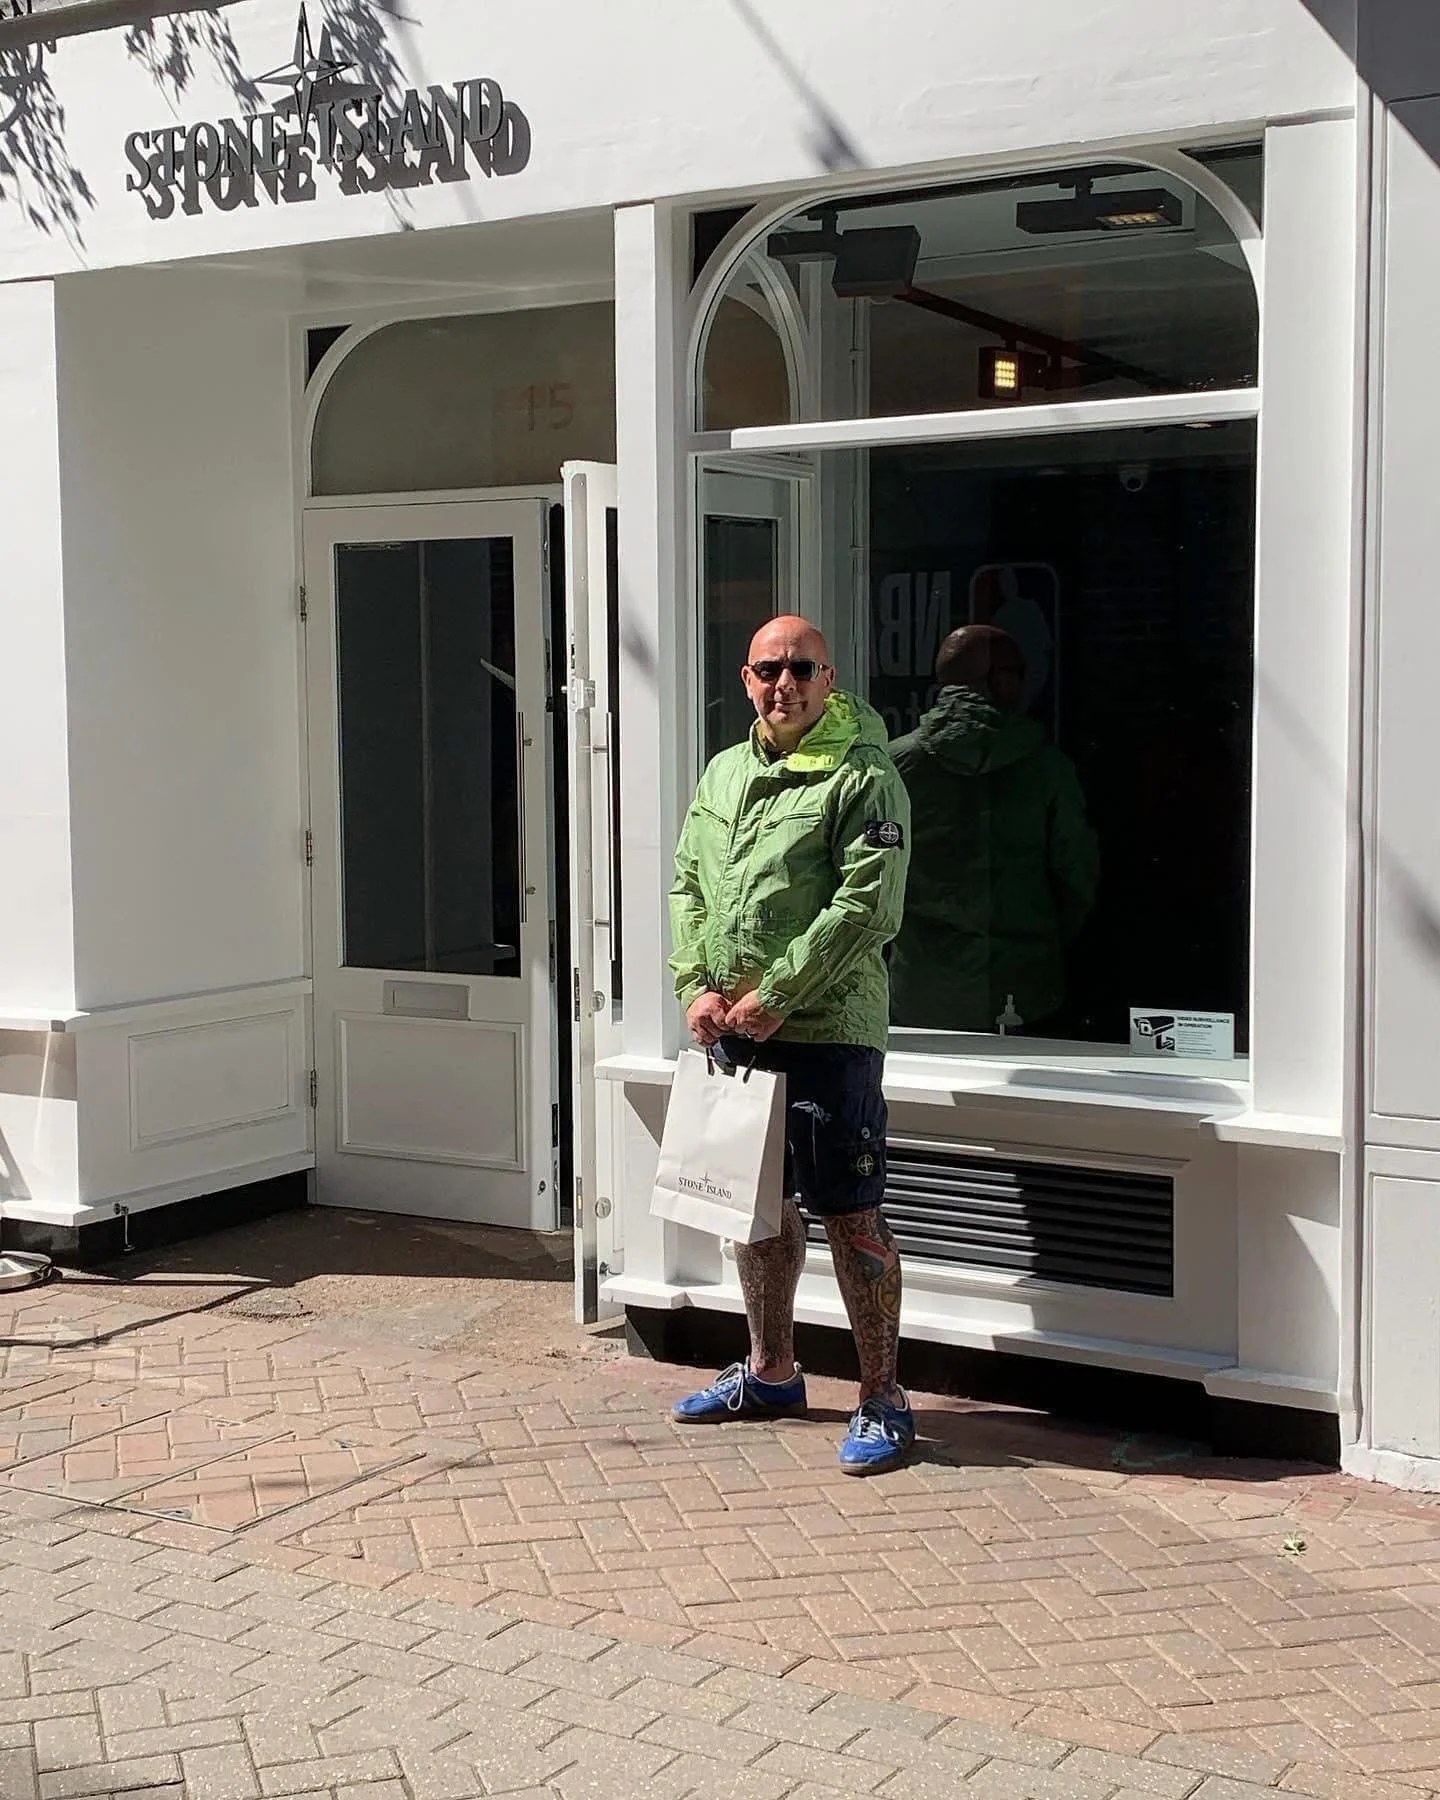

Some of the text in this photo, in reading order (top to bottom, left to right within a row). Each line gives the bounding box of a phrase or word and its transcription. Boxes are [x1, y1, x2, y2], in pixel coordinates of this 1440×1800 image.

[125, 78, 503, 192] STONE ISLAND
[523, 381, 574, 431] 15
[678, 1177, 731, 1199] STONE ISLAND
